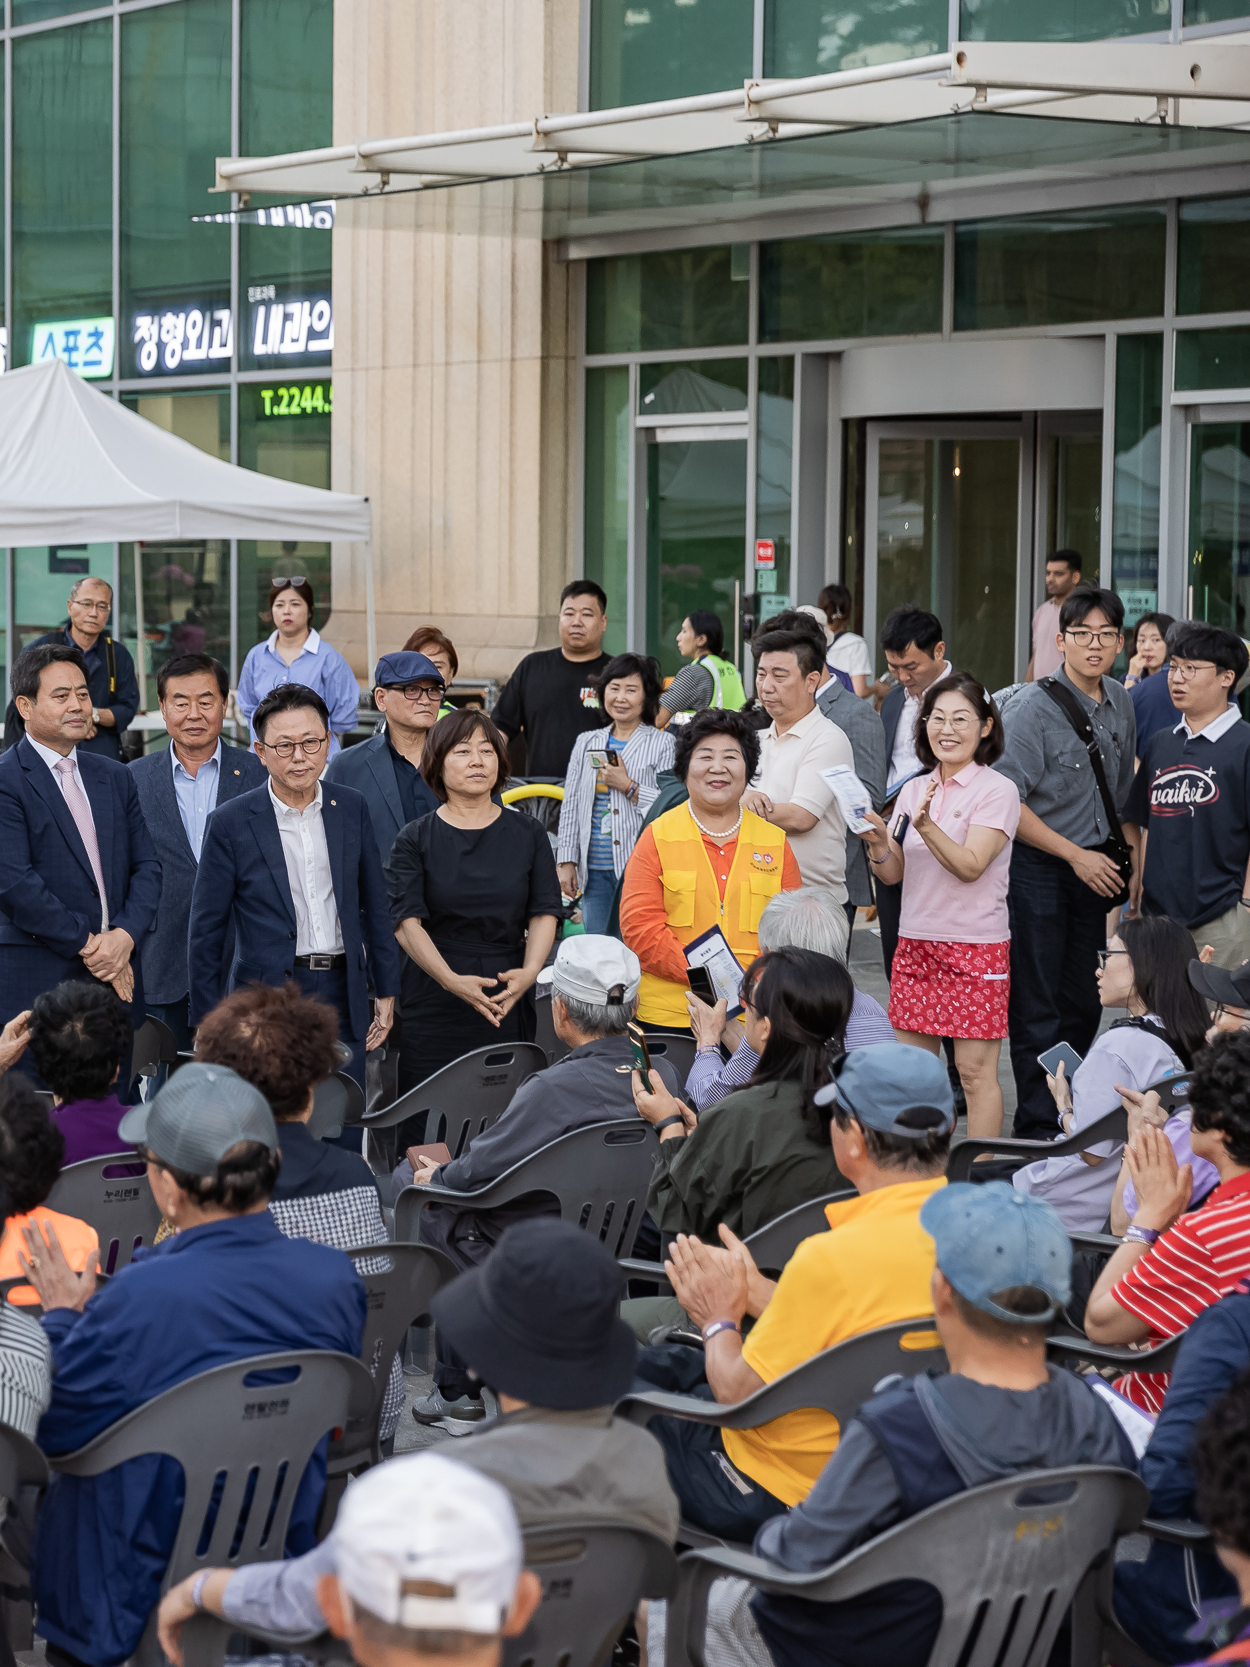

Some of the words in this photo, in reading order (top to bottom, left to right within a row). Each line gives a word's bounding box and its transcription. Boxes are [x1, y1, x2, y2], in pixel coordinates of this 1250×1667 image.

[41, 327, 104, 368] 스포츠
[134, 309, 234, 371] 정형외과
[261, 385, 333, 416] T.2244.
